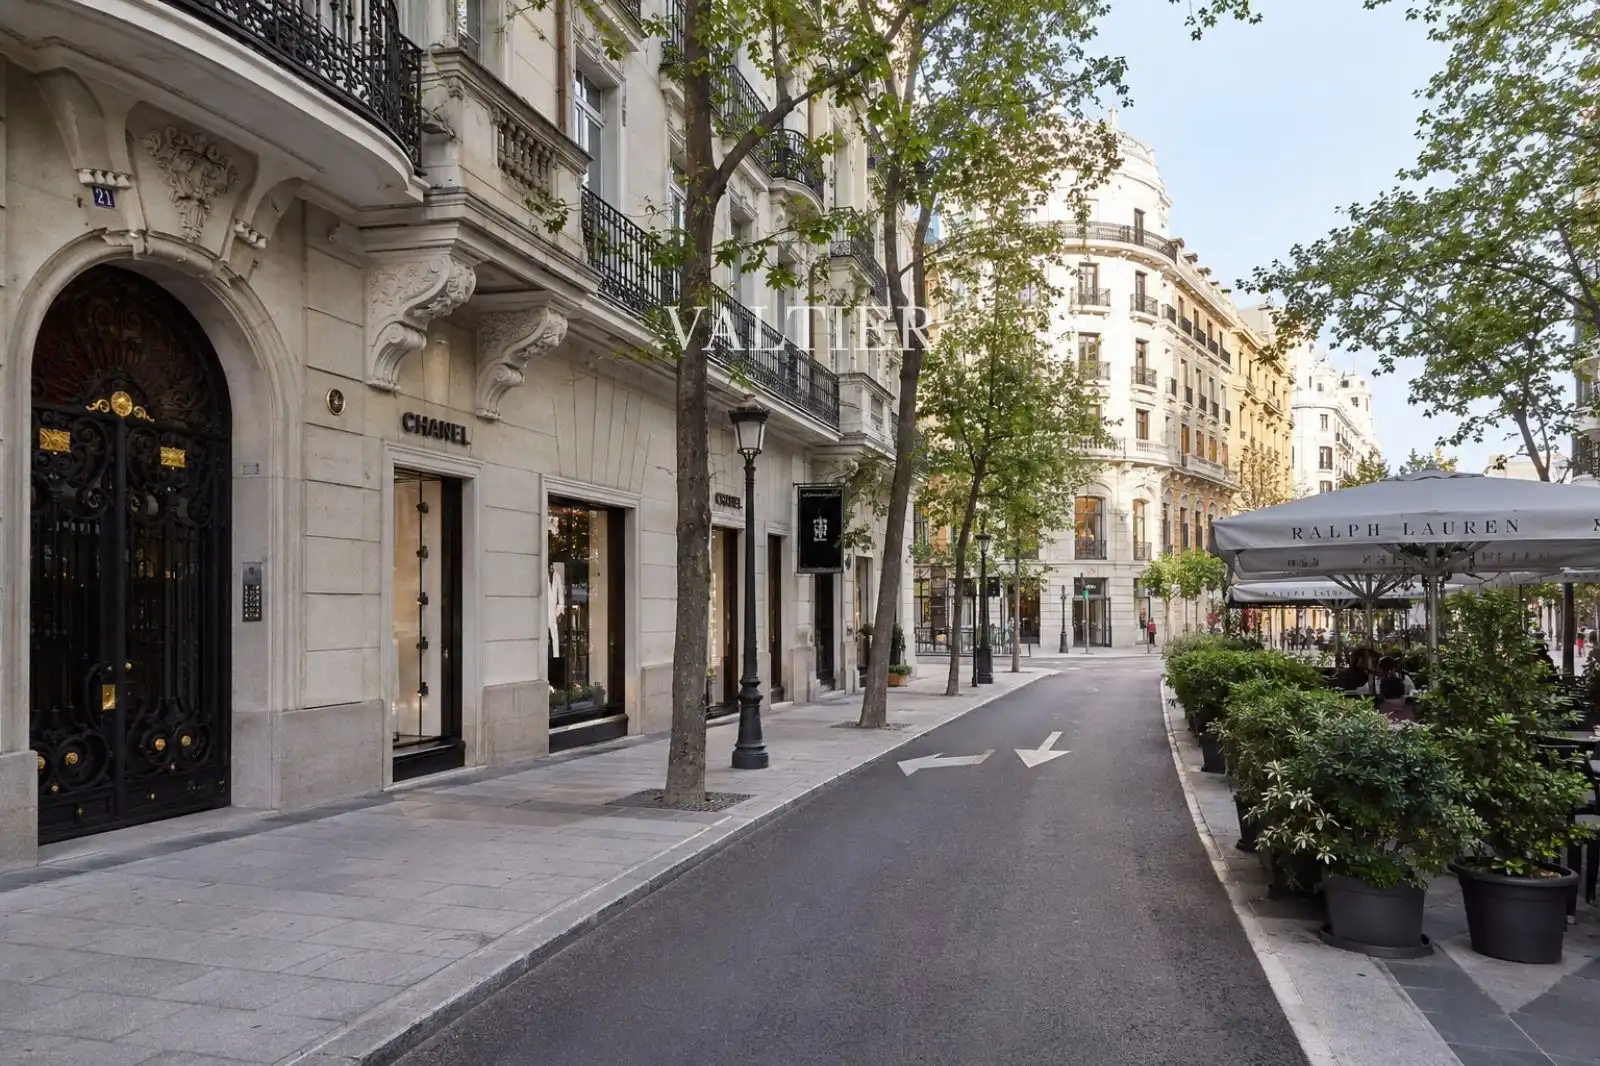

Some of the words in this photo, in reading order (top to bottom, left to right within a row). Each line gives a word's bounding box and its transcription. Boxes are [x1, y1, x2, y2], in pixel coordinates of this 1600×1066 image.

[95, 188, 112, 206] 21
[402, 412, 472, 446] CHANEL
[715, 492, 743, 509] CEL
[1291, 523, 1380, 540] RALPH
[1403, 519, 1519, 536] LAUREN
